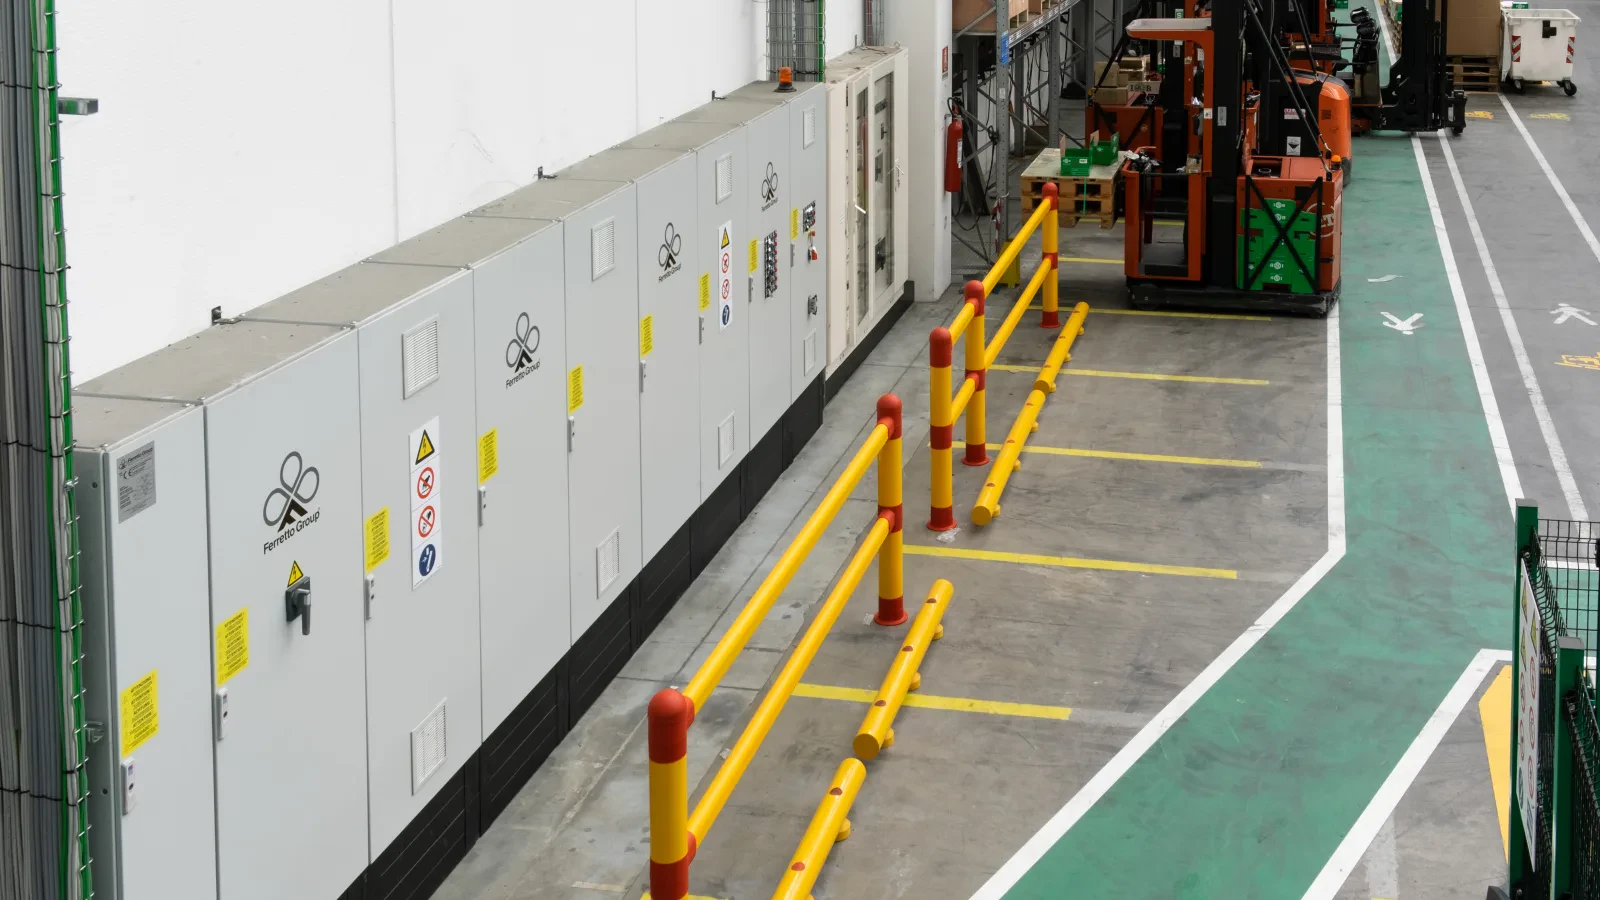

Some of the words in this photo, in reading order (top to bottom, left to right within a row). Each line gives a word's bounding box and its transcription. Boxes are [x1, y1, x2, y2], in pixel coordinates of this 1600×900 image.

[659, 270, 672, 284] Ferretto
[671, 263, 682, 275] Group
[506, 371, 525, 390] Ferretto
[525, 361, 541, 376] Group
[263, 527, 296, 555] Ferretto
[296, 510, 320, 532] Group
